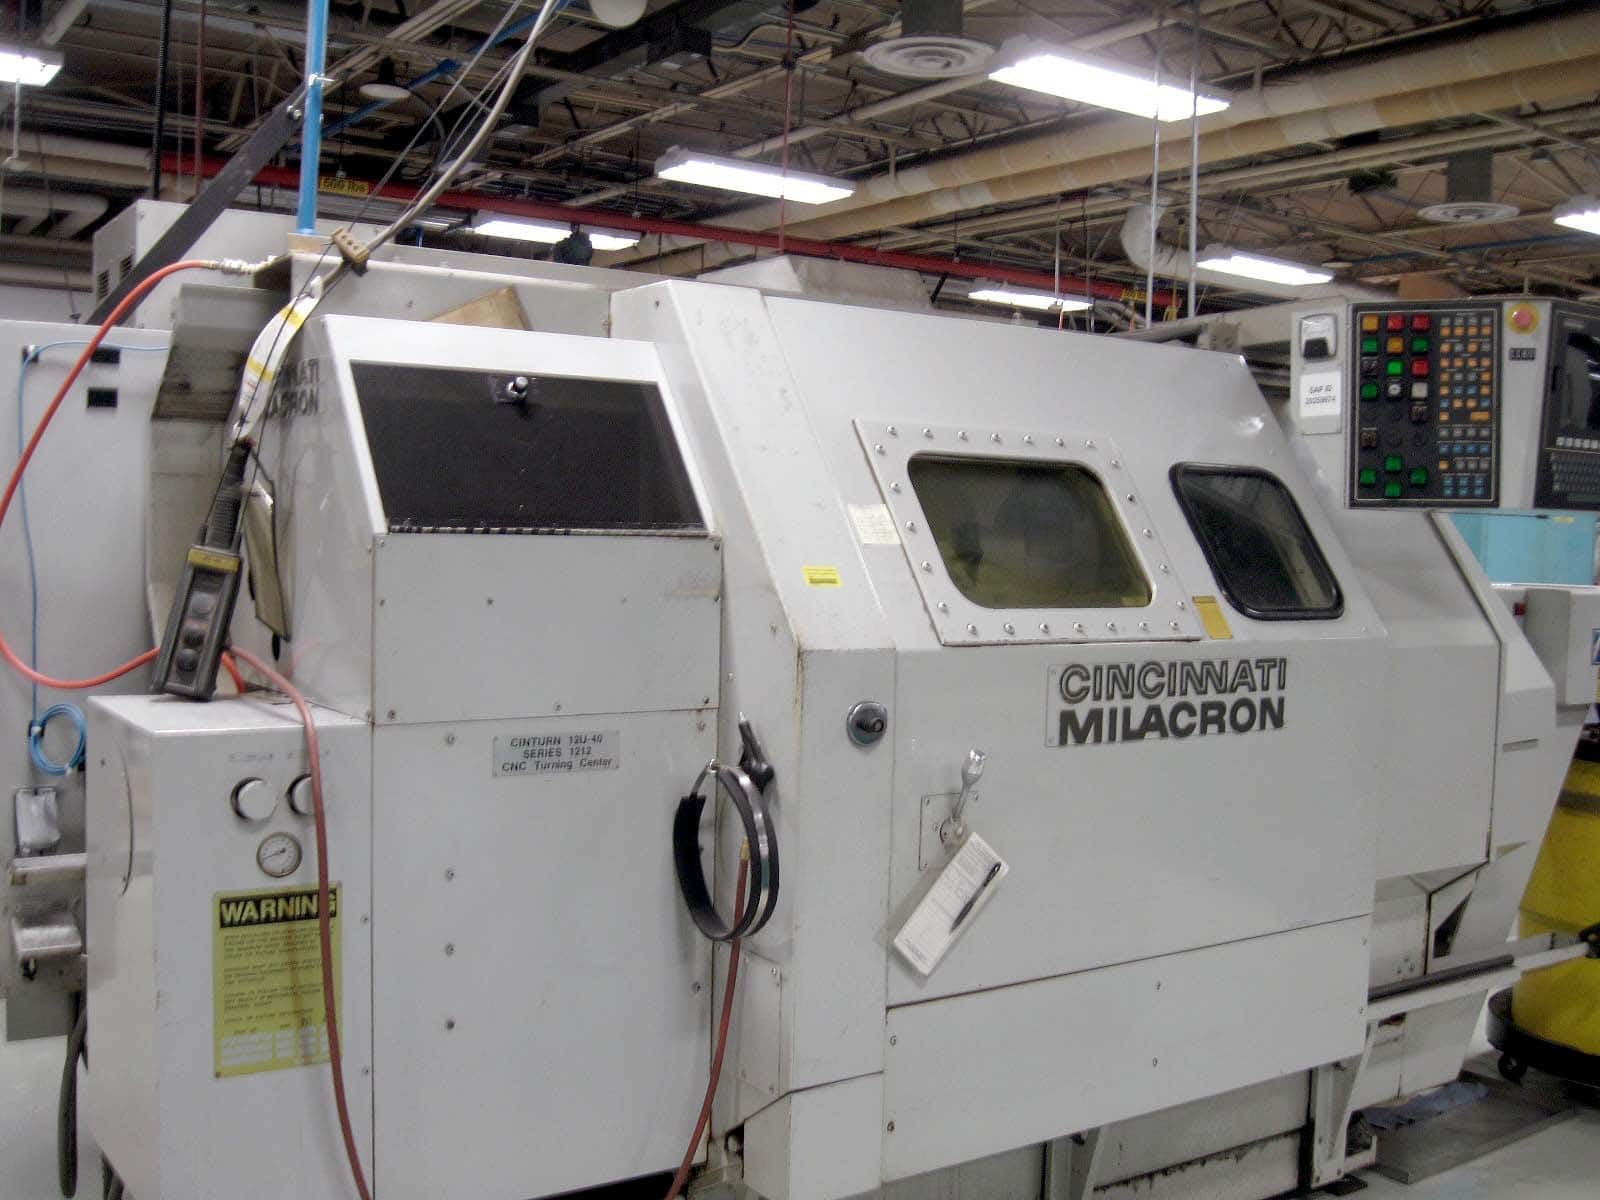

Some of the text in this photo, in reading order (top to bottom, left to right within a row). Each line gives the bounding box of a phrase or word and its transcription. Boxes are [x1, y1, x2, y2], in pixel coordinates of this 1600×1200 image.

[1059, 658, 1287, 704] CINCINNATI
[1058, 697, 1286, 746] MILACRON
[510, 736, 561, 748] CINTURN
[523, 746, 592, 760] SERIES 1212
[502, 757, 612, 772] CNC Turning Center
